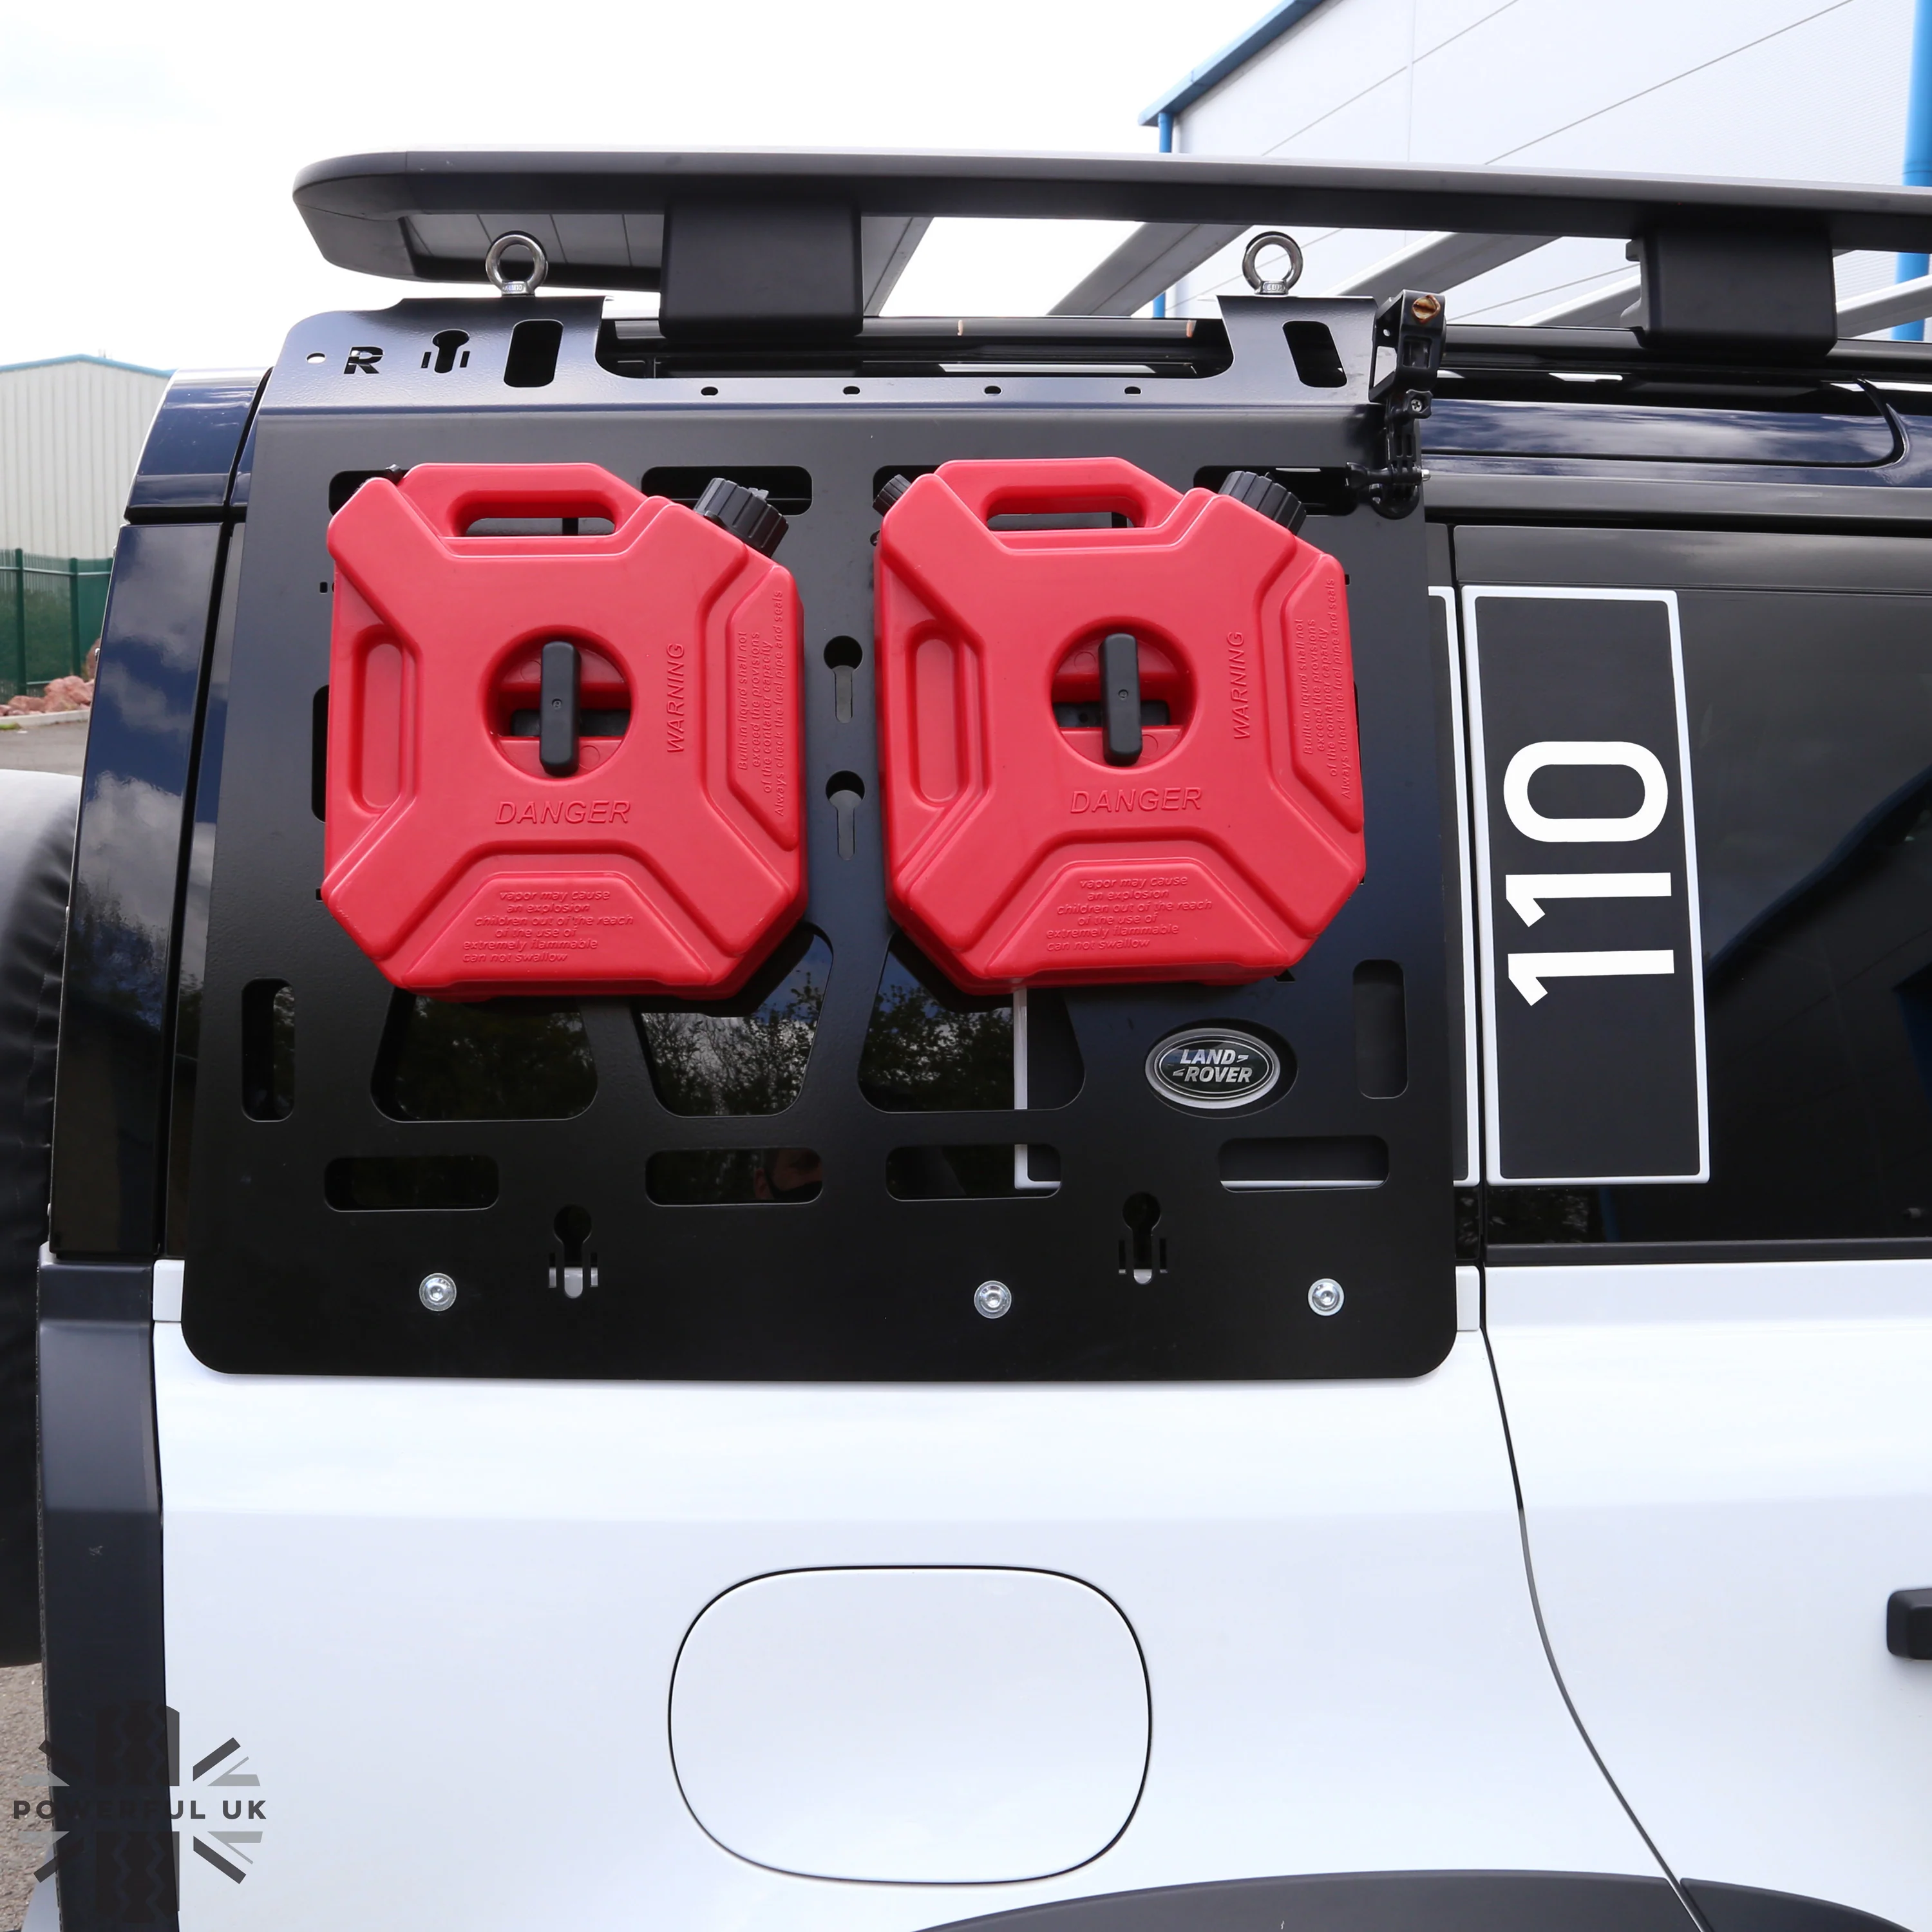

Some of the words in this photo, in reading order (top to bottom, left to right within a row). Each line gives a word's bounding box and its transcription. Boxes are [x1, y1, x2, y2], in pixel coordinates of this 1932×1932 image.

[772, 591, 782, 622] seals
[1325, 579, 1336, 609] seals
[1294, 619, 1303, 638] not
[1327, 612, 1339, 635] and
[737, 631, 747, 652] not
[773, 625, 783, 649] and
[1295, 642, 1307, 670] shall
[1307, 619, 1322, 683] provisions
[1319, 627, 1332, 678] capacity
[1331, 638, 1343, 665] pipe
[737, 654, 747, 684] shall
[750, 632, 762, 697] provisions
[761, 641, 773, 693] capacity
[773, 652, 786, 678] pipe
[1227, 631, 1251, 740] WARNING
[1297, 675, 1311, 708] liquid
[1332, 668, 1344, 692] fuel
[667, 643, 685, 753] WARNING
[737, 688, 750, 723] liquid
[773, 681, 784, 706] fuel
[1312, 686, 1321, 706] the
[1334, 694, 1345, 713] the
[750, 700, 761, 721] the
[773, 708, 784, 728] the
[1322, 682, 1335, 739] container
[762, 696, 772, 754] container
[1300, 711, 1313, 755] Built-in
[1312, 708, 1325, 752] exceed
[1336, 717, 1348, 752] check
[737, 724, 748, 771] Built-in
[750, 723, 761, 768] exceed
[774, 732, 784, 768] check
[1327, 741, 1336, 761] the
[761, 756, 772, 777] the
[1327, 764, 1337, 777] of
[1341, 755, 1352, 799] Always
[761, 780, 772, 793] of
[774, 772, 786, 817] Always
[495, 800, 630, 825] DANGER
[1070, 787, 1202, 814] DANGER
[1079, 878, 1117, 889] vapor
[1119, 878, 1147, 889] may
[1150, 876, 1188, 886] cause
[1503, 741, 1674, 1007] 110
[500, 891, 536, 902] vapor
[540, 891, 568, 902] may
[572, 891, 610, 900] cause
[507, 904, 522, 913] an
[526, 902, 590, 913] explosion
[1057, 903, 1109, 915] children
[1113, 903, 1135, 913] out
[1137, 902, 1151, 912] of
[1154, 901, 1173, 911] the
[1177, 899, 1212, 910] reach
[1087, 892, 1103, 901] an
[1108, 889, 1170, 900] explosion
[475, 916, 529, 926] children
[532, 916, 553, 925] out
[556, 915, 571, 925] of
[573, 916, 594, 925] the
[596, 914, 634, 925] reach
[1077, 914, 1092, 925] of
[1094, 914, 1114, 925] the
[1118, 914, 1141, 924] use
[1144, 912, 1159, 923] of
[495, 927, 509, 938] of
[513, 927, 532, 938] the
[536, 928, 560, 937] use
[564, 926, 578, 937] of
[1046, 927, 1110, 940] extremely
[1112, 924, 1179, 936] flammable
[462, 953, 486, 962] can
[490, 952, 511, 962] not
[515, 952, 568, 962] swallow
[463, 940, 527, 952] extremely
[530, 938, 598, 949] flammable
[1046, 942, 1070, 952] can
[1074, 940, 1095, 950] not
[1099, 938, 1150, 949] swallow
[1180, 1049, 1236, 1065] LAND
[1184, 1066, 1253, 1083] ROVER
